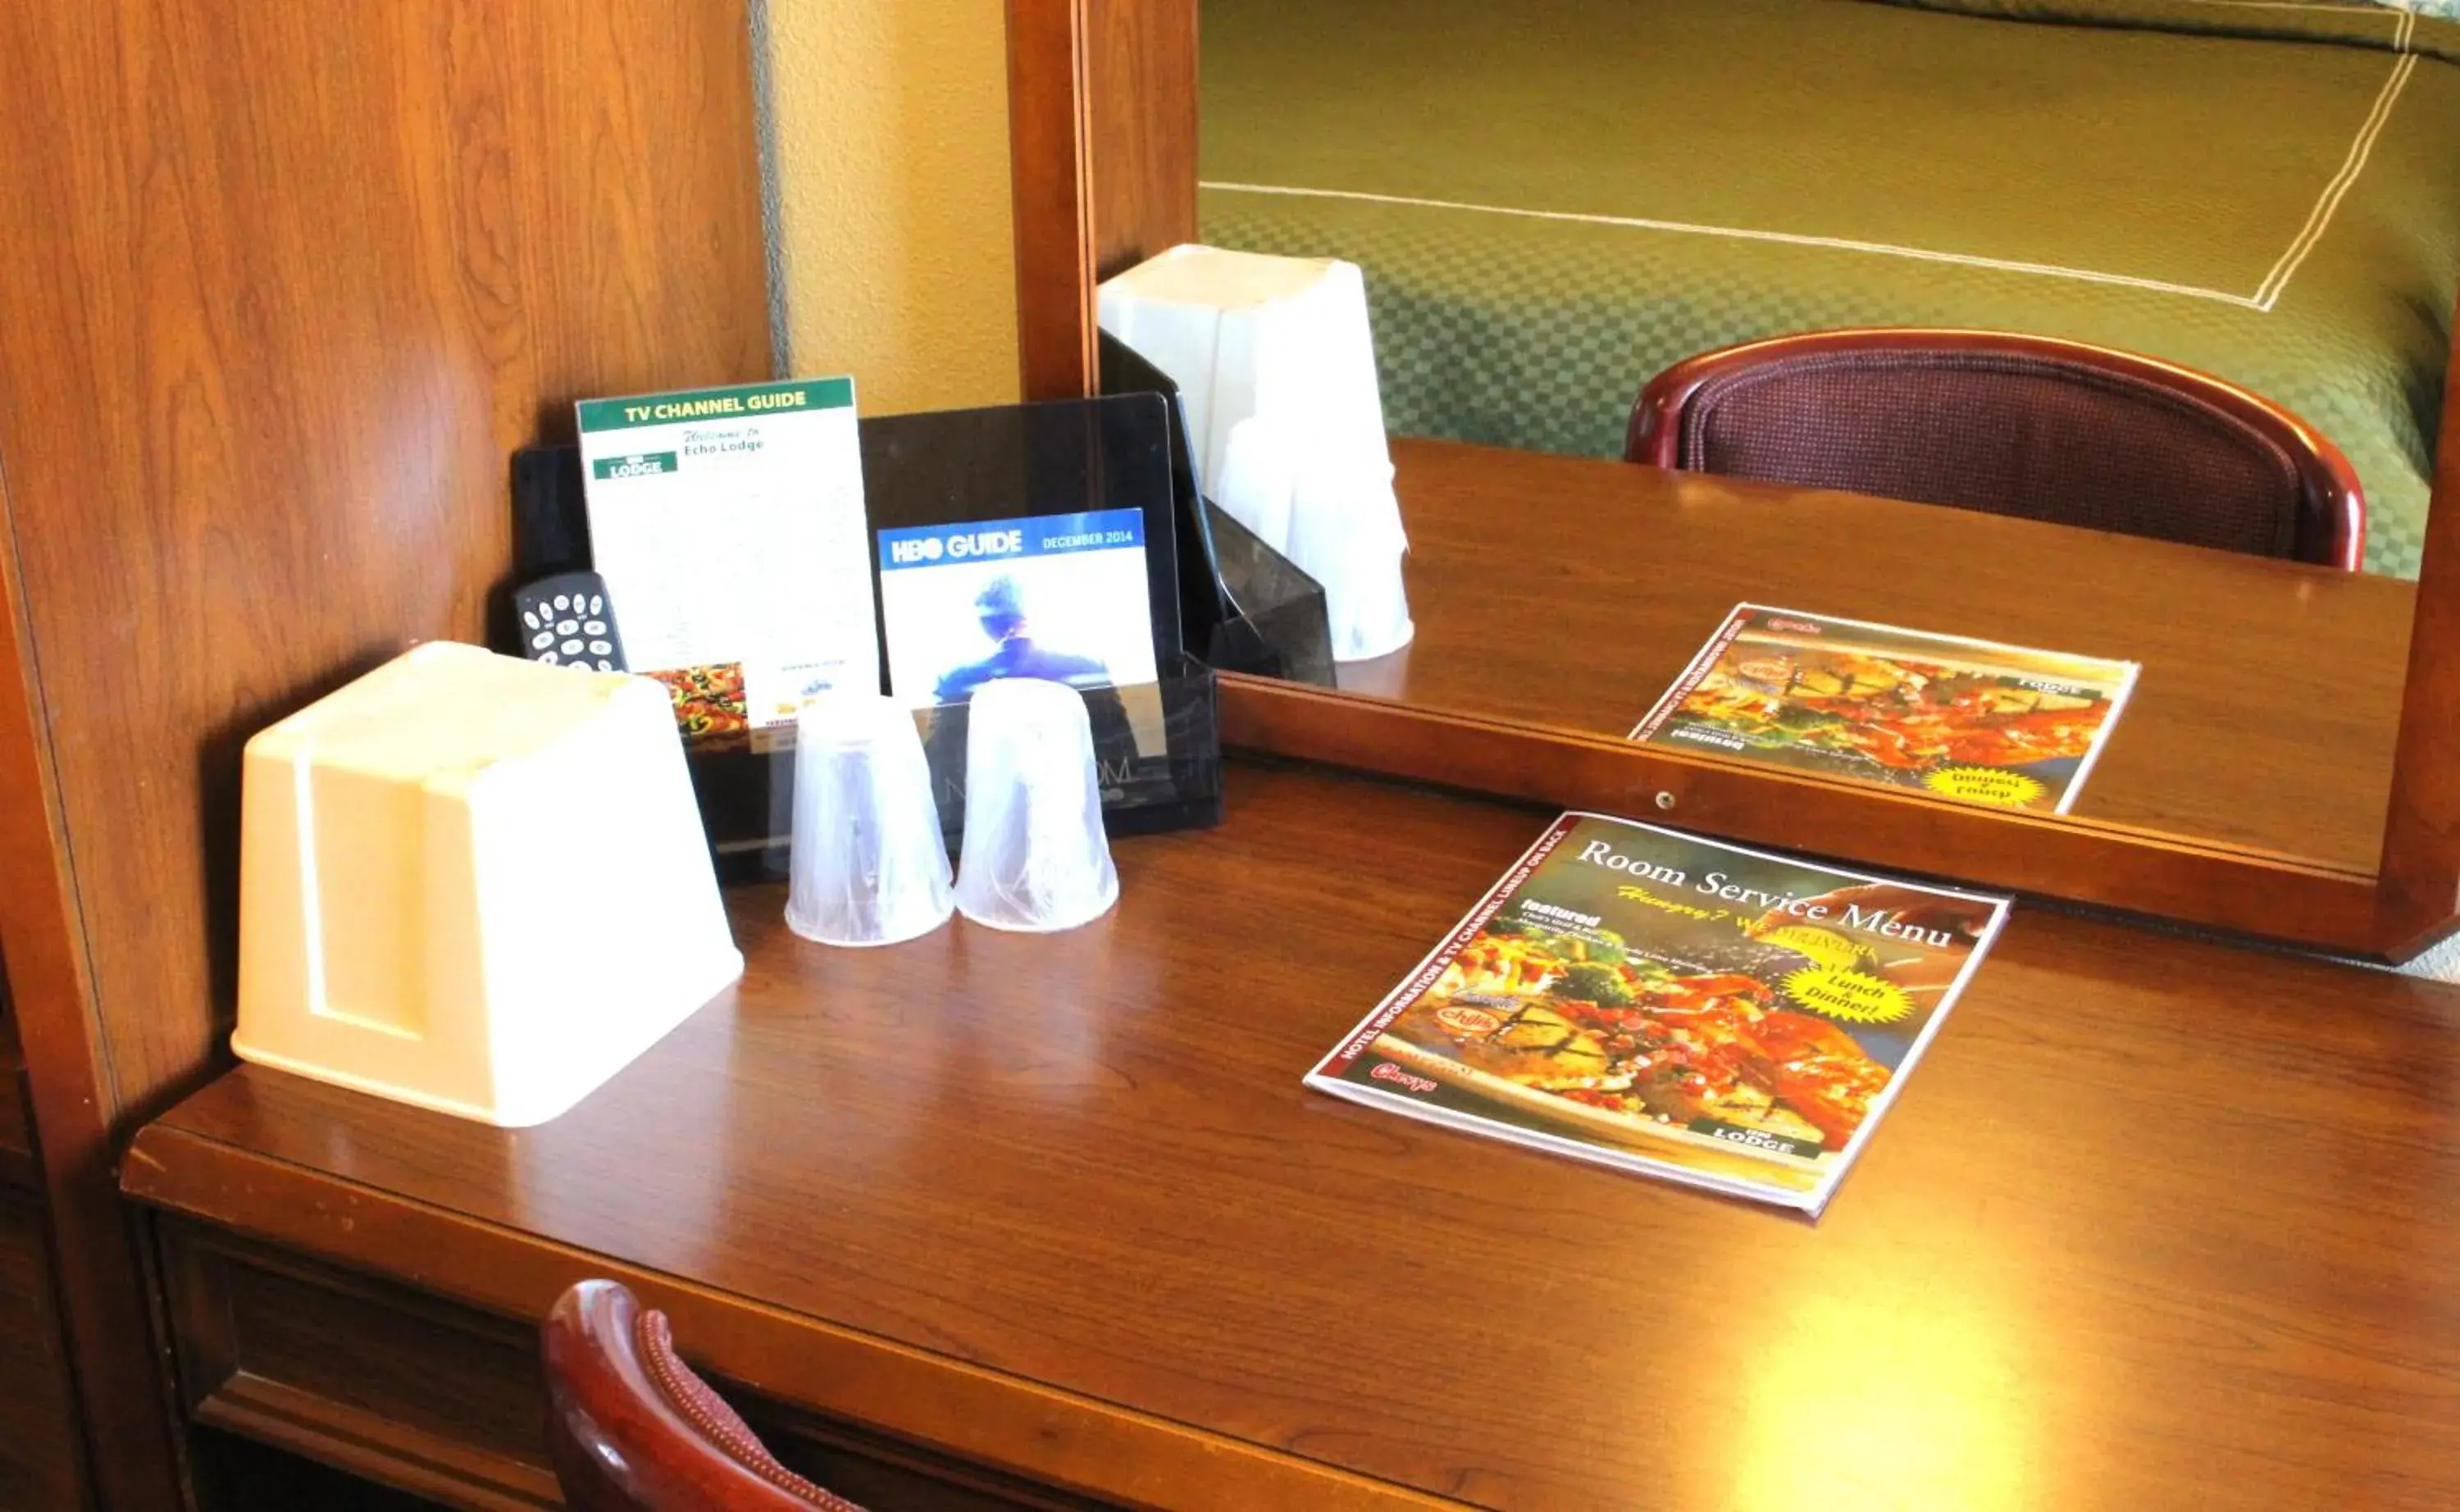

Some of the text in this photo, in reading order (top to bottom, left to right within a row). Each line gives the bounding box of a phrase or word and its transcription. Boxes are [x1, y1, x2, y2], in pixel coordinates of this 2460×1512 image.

[625, 391, 807, 422] TV CHANNEL GUIDE
[684, 439, 764, 456] Echo Lodge
[609, 461, 663, 479] LODGE
[891, 530, 1133, 563] HBO GUIDE DECEMBER 2014
[1576, 840, 1953, 949] Room Service Menu
[1520, 899, 1601, 927] featured
[1341, 1028, 1379, 1059] HOTEL
[1375, 968, 1440, 1031] INFORMATION
[1459, 899, 1504, 945] CHANNEL
[1499, 866, 1531, 899] LINEUP
[1527, 849, 1545, 868] ON
[1539, 830, 1567, 855] BACK
[1805, 986, 1879, 1016] Dinner!
[1828, 974, 1885, 999] Lunch
[1714, 1127, 1794, 1154] LODGE
